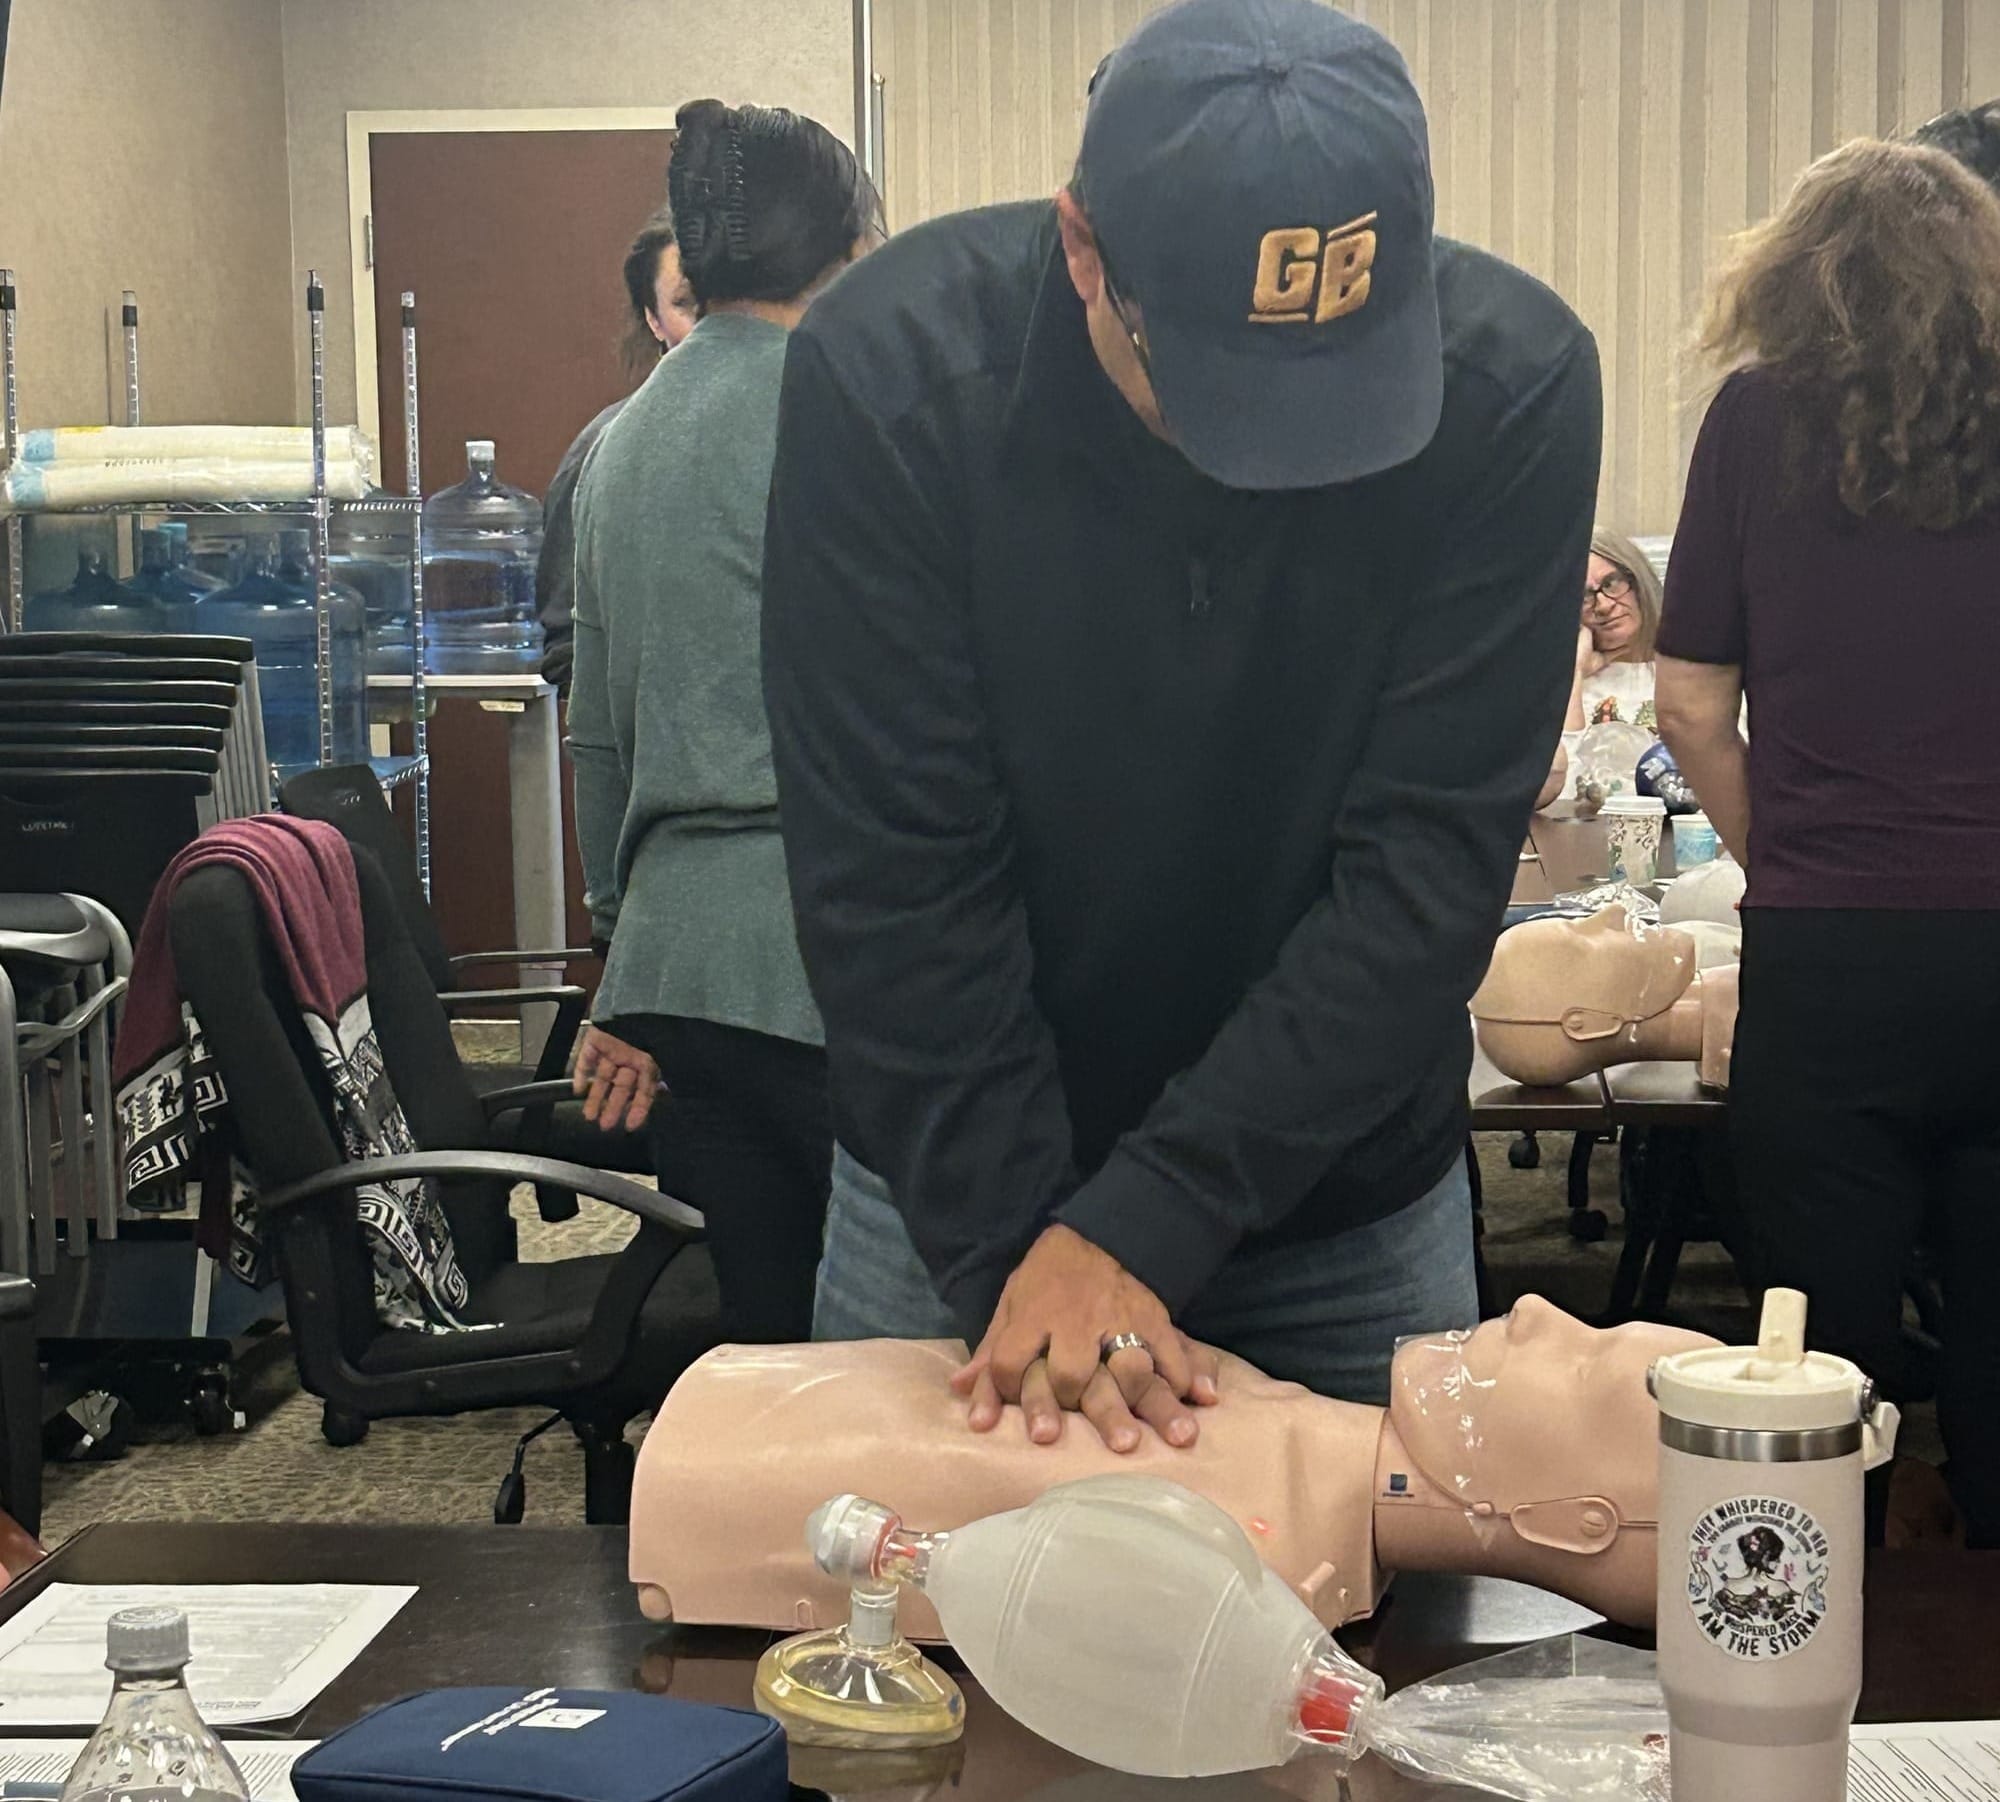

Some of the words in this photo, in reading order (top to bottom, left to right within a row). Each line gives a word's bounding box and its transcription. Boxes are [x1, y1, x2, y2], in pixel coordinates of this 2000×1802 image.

[1248, 211, 1377, 324] GB
[1714, 1498, 1796, 1521] WHISPERED
[1797, 1513, 1813, 1532] TO
[1810, 1530, 1829, 1557] HER
[1697, 1611, 1725, 1640] AM
[1727, 1631, 1760, 1657] THE
[1768, 1609, 1821, 1655] STORM
